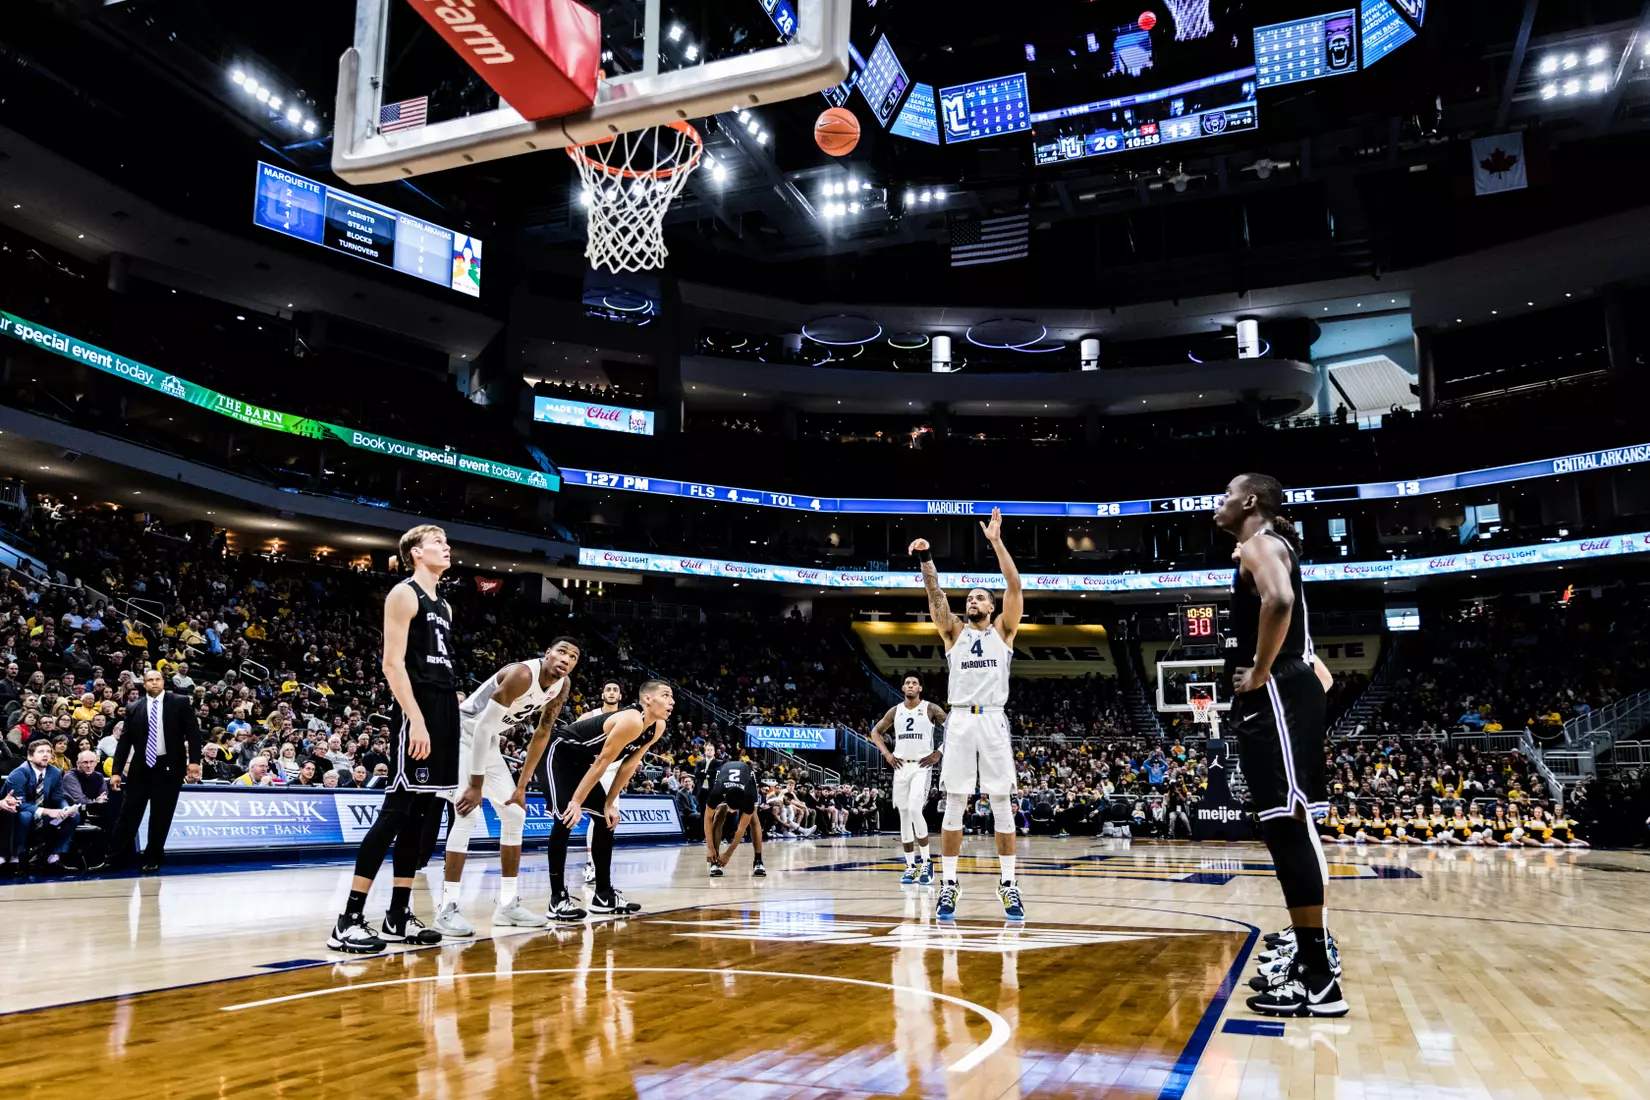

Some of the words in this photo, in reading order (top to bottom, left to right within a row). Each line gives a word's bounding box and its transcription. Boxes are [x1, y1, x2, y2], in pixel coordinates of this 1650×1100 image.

[777, 10, 794, 33] 26
[1143, 126, 1154, 134] 30
[1168, 123, 1192, 138] 13
[1094, 135, 1118, 151] 26
[1126, 135, 1160, 148] 10:58
[264, 167, 320, 194] MARQUETTE
[285, 200, 291, 208] 2
[346, 209, 375, 224] ASSISTS
[347, 220, 373, 235] STEALS
[399, 216, 424, 231] CENTRAL
[423, 226, 452, 240] ARKANSAS
[346, 231, 373, 245] BLOCKS
[338, 239, 379, 258] TURNOVERS
[14, 323, 70, 353] special
[72, 344, 112, 369] event
[115, 358, 155, 386] today.
[217, 393, 242, 413] THE
[244, 404, 283, 424] BARN
[546, 403, 571, 412] MADE
[572, 407, 585, 415] TO
[586, 406, 622, 422] Chill
[352, 432, 385, 450] Book
[387, 441, 415, 457] your
[416, 447, 457, 466] special
[459, 457, 490, 474] event
[491, 463, 523, 481] today.
[1553, 454, 1600, 473] CENTRAL
[585, 472, 620, 487] 1:27
[623, 477, 649, 491] PM
[690, 485, 715, 498] FLS
[727, 489, 738, 501] 4
[1396, 482, 1420, 495] 13
[770, 494, 796, 507] TOL
[810, 499, 821, 511] 4
[1285, 490, 1315, 503] 1st
[927, 502, 974, 514] MARQUETTE
[1097, 504, 1121, 516] 26
[1580, 539, 1611, 551] Chill
[603, 552, 628, 563] Coors
[628, 556, 649, 564] LIGHT
[1483, 552, 1512, 562] Coors
[1511, 550, 1537, 559] LIGHT
[680, 559, 703, 569] Chill
[725, 563, 747, 573] Coors
[1343, 564, 1369, 574] Coors
[1429, 558, 1455, 568] Chill
[797, 570, 819, 579] Chill
[841, 573, 863, 582] Coors
[961, 575, 984, 584] Coors
[1037, 576, 1060, 585] Chill
[1083, 576, 1106, 585] Coors
[1158, 574, 1182, 583] Chill
[1207, 572, 1232, 581] Coors
[1187, 608, 1213, 618] 10:58
[1188, 618, 1211, 636] 30
[970, 639, 984, 657] 4
[961, 659, 998, 669] MARQUETTE
[905, 717, 915, 731] 2
[757, 728, 790, 738] TOWN
[793, 729, 826, 743] BANK
[801, 741, 818, 749] BANK
[728, 769, 741, 781] 2
[174, 800, 241, 817] OWN
[249, 800, 328, 822] BANK
[619, 809, 671, 822] NTRUST
[1198, 806, 1241, 824] meijer
[171, 828, 180, 837] A
[184, 825, 269, 836] WINTRUST
[273, 824, 312, 835] BANK
